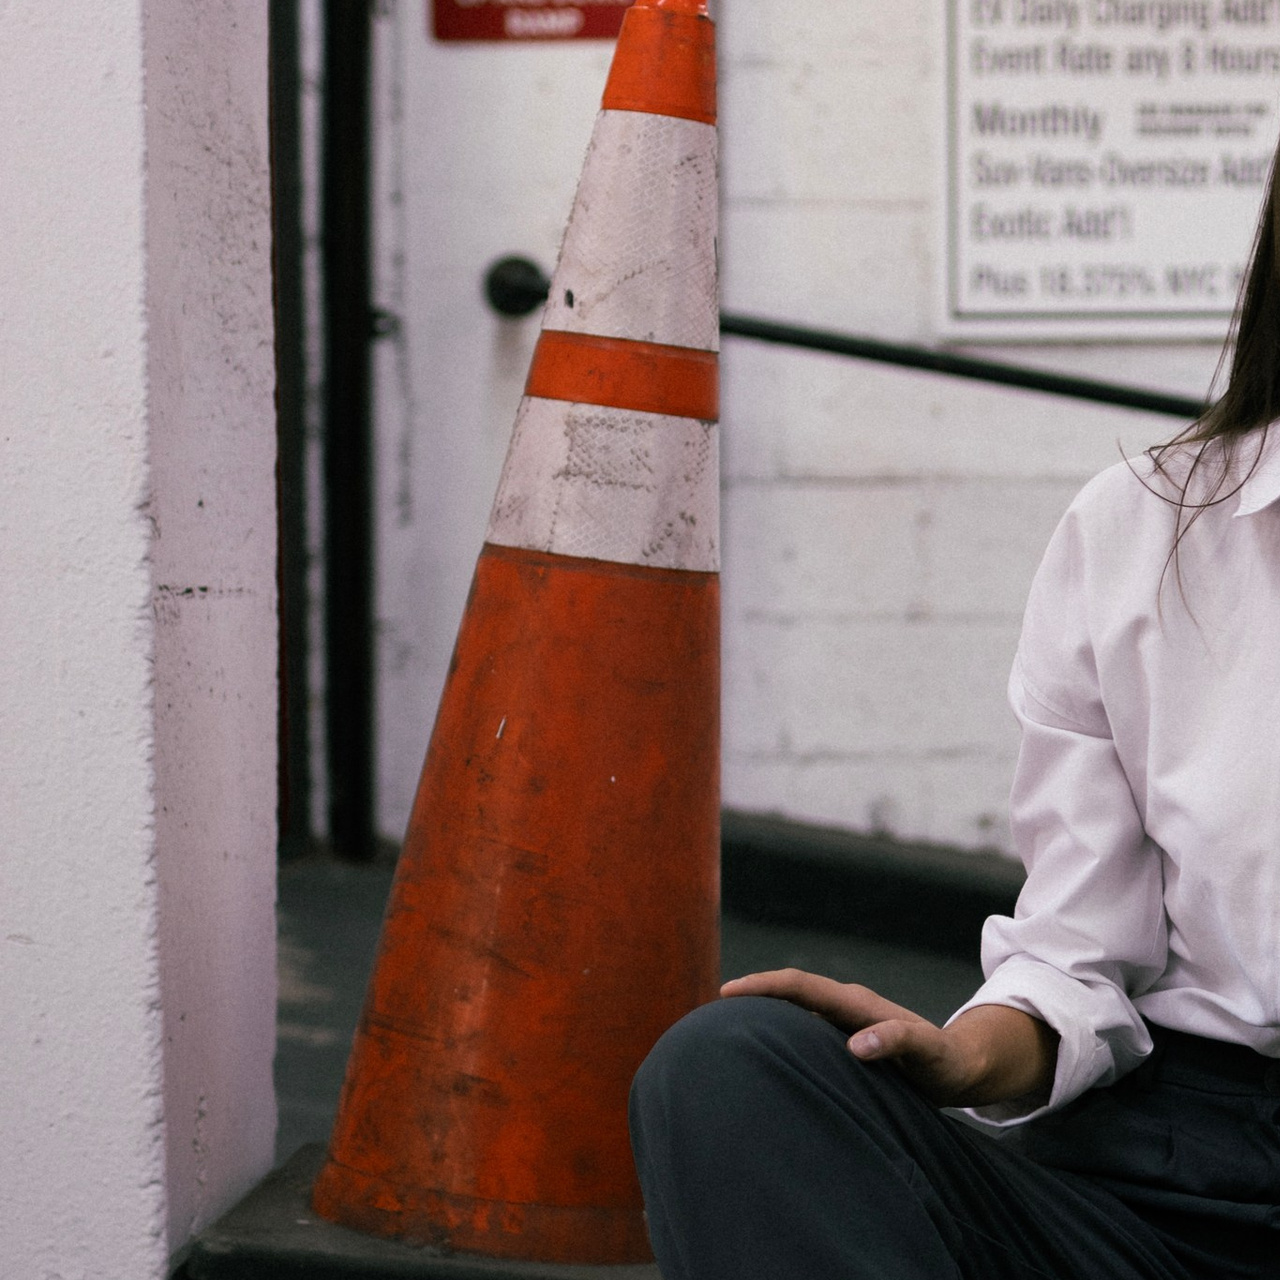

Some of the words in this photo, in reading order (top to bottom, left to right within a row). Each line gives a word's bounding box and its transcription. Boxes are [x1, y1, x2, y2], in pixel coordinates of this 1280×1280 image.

[970, 40, 1047, 77] Event
[1054, 40, 1117, 77] Rate
[1122, 47, 1171, 83] any
[971, 101, 1105, 146] Monthly
[970, 204, 1056, 243] Exotic
[970, 266, 1032, 300] Plus
[1165, 265, 1222, 300] NYC
